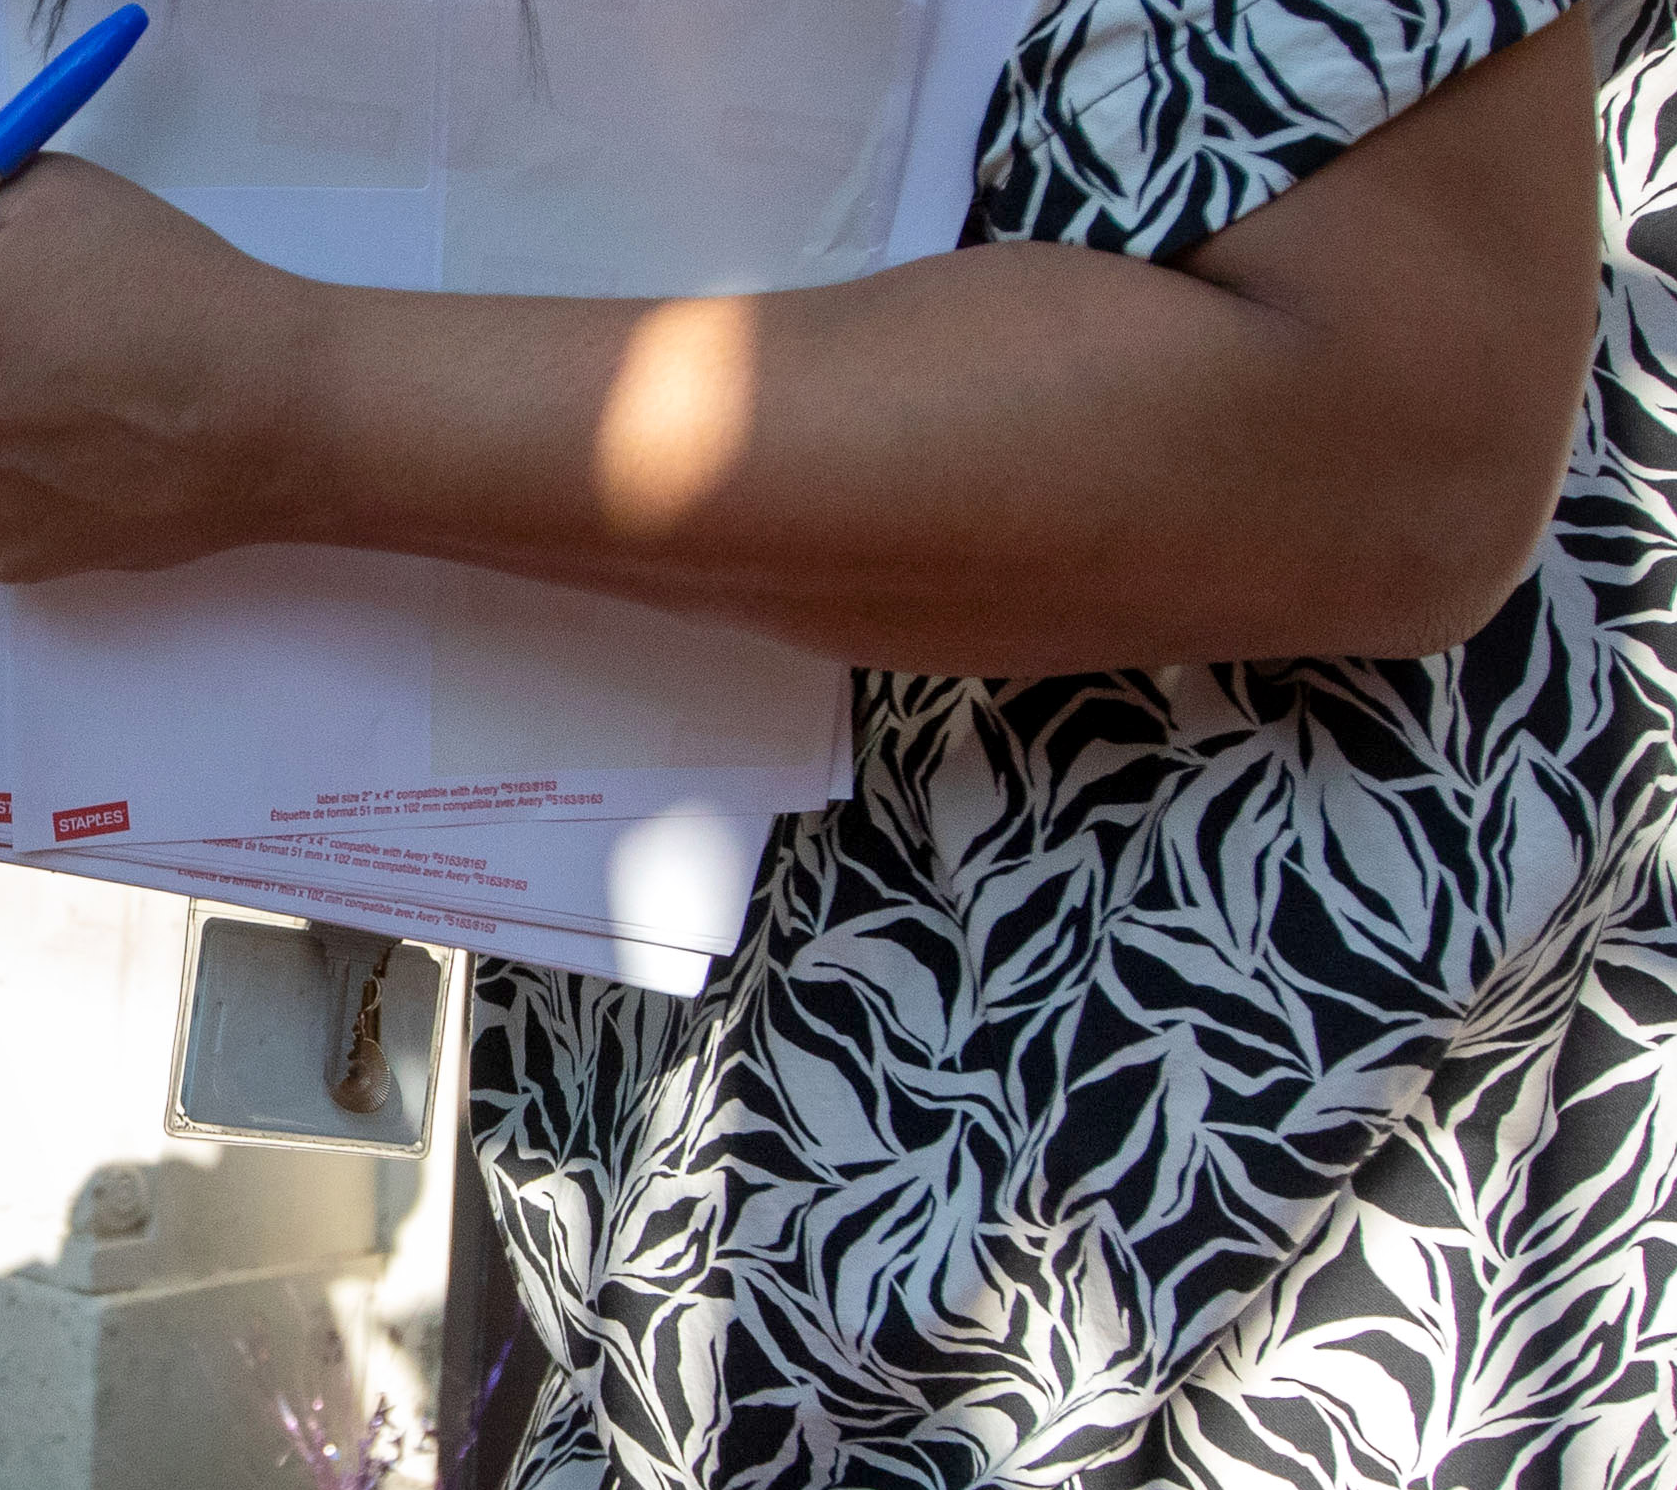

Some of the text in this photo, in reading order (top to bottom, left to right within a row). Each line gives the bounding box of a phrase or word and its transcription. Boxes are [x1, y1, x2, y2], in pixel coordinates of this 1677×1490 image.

[316, 792, 339, 804] label
[341, 791, 359, 802] size
[396, 786, 447, 800] compatible
[450, 785, 470, 796] with
[472, 784, 497, 797] Avery
[59, 810, 123, 832] STAPLES
[270, 806, 310, 822] Étiquette
[312, 808, 324, 819] de
[326, 806, 357, 818] format
[359, 805, 370, 816] 51
[403, 802, 420, 813] 102
[443, 798, 492, 811] compatible
[494, 798, 515, 808] avec
[516, 795, 542, 808] Avery
[258, 842, 288, 855] format
[290, 847, 302, 857] 51
[333, 852, 351, 865] 102
[371, 858, 421, 876] compatible
[422, 867, 444, 878] avec
[444, 869, 470, 884] Avery
[329, 837, 380, 855] compatible
[382, 846, 402, 857] with
[402, 849, 429, 863] Avery
[343, 897, 393, 916] compatible
[394, 907, 415, 919] avec
[416, 910, 442, 925] Avery
